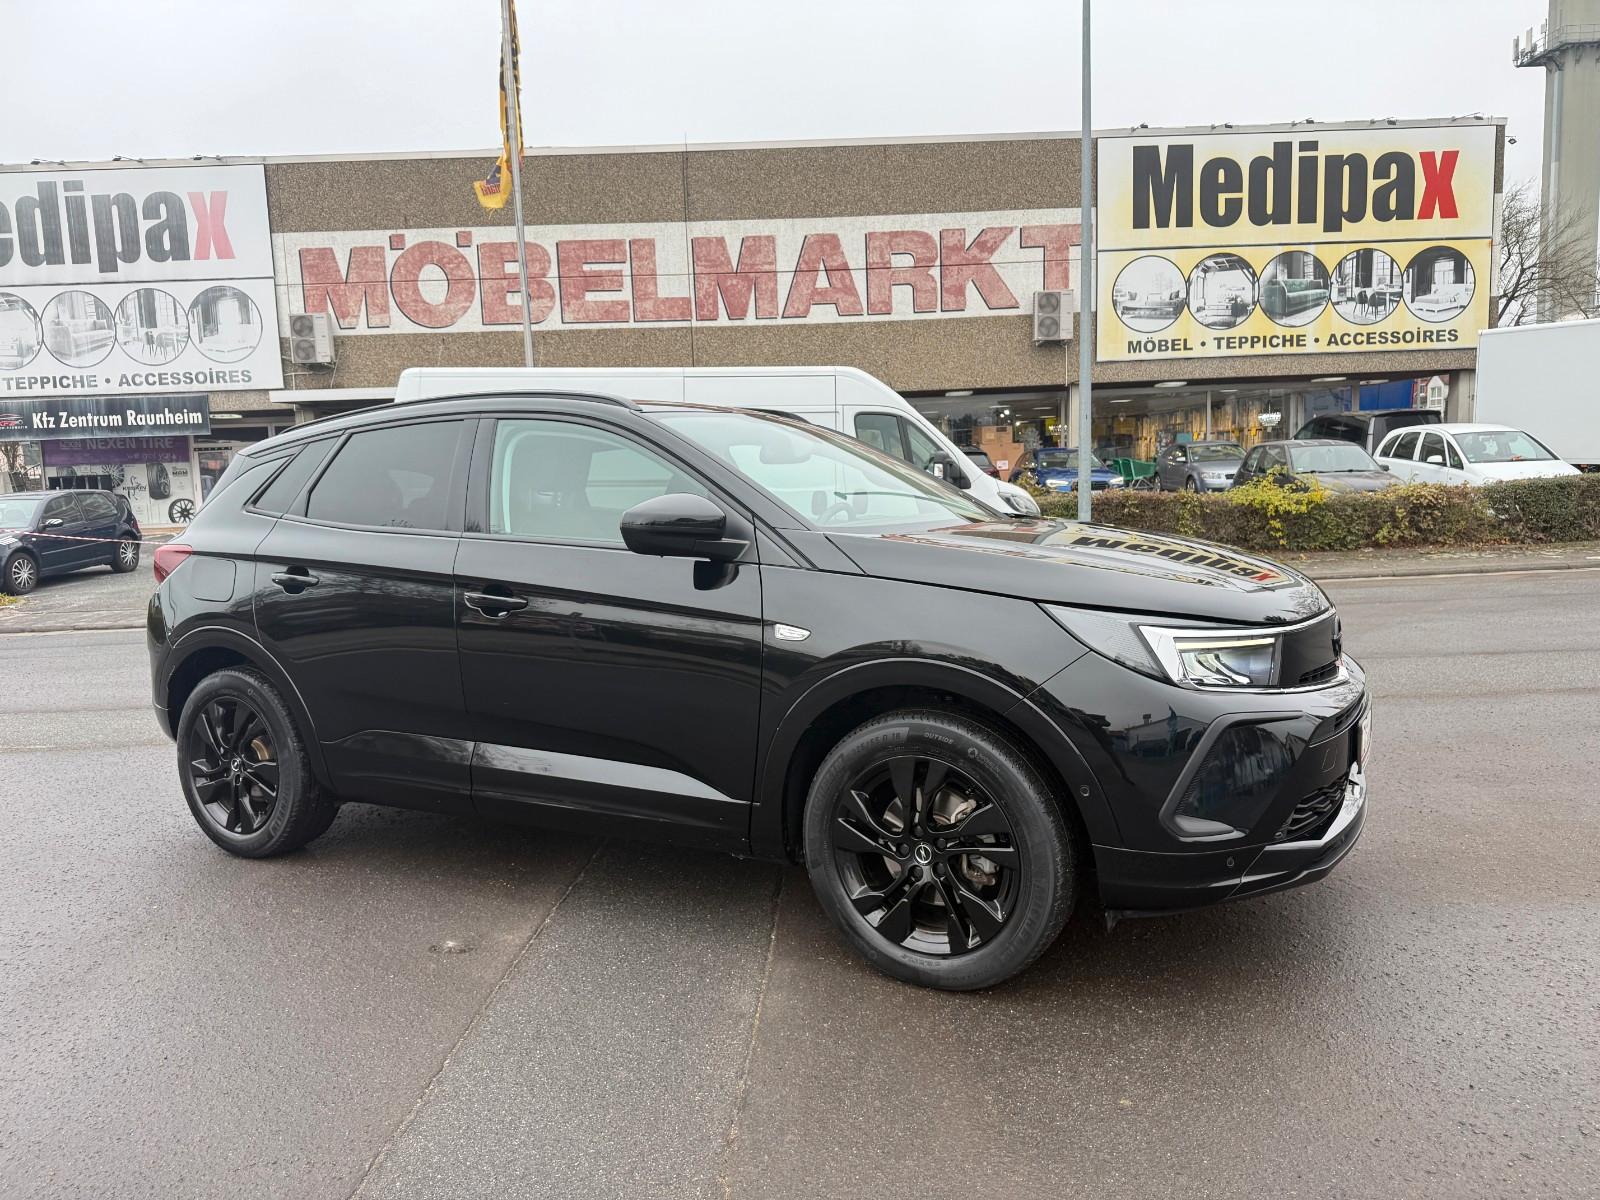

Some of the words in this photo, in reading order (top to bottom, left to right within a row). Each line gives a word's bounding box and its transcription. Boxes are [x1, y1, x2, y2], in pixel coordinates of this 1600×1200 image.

[1132, 140, 1460, 233] Medipax
[1127, 337, 1194, 354] MÖBEL
[1213, 334, 1308, 350] TEPPICHE
[3, 374, 98, 391] TEPPICHE
[32, 411, 55, 429] Kfz
[59, 410, 123, 428] Zentrum
[127, 407, 203, 426] Raunheim
[86, 438, 137, 450] NEXEN
[138, 437, 175, 449] TIRE
